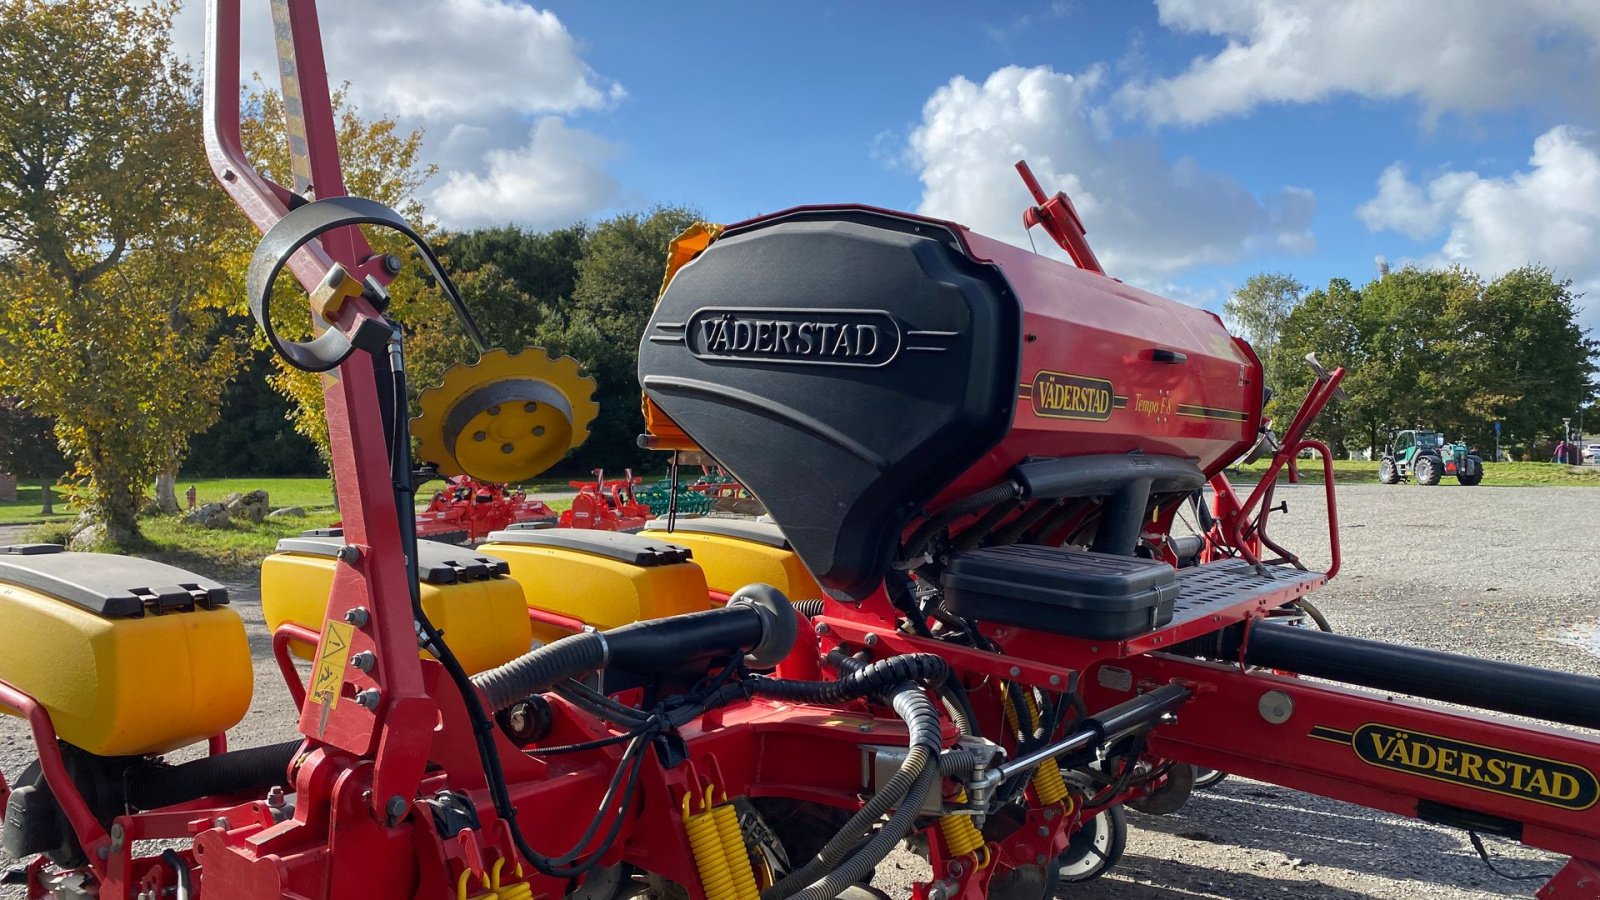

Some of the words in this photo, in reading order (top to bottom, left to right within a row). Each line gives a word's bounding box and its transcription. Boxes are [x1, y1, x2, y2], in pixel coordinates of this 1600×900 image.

[700, 314, 877, 356] VÄDERSTAD
[1039, 376, 1109, 414] VÄDERSTAD
[1135, 393, 1158, 416] Tempo
[1370, 731, 1580, 800] VÄDERSTAD
